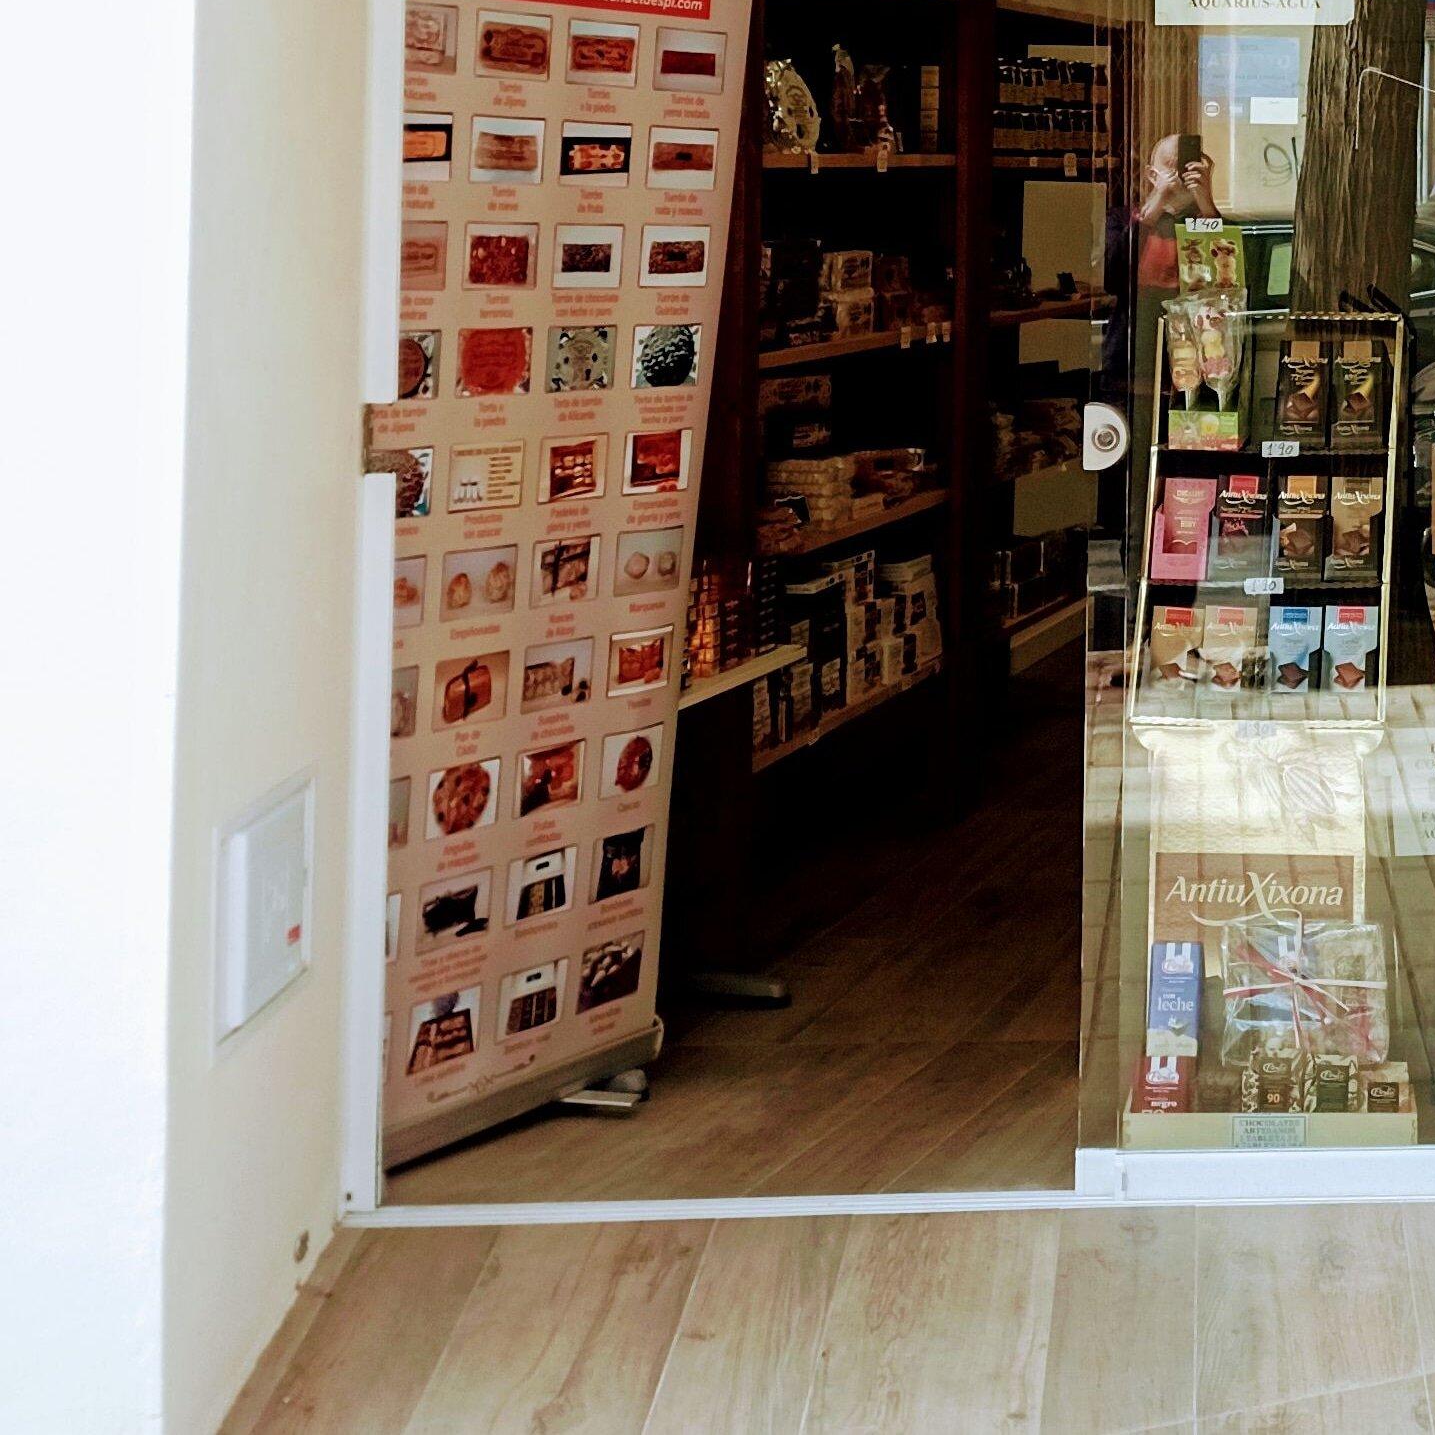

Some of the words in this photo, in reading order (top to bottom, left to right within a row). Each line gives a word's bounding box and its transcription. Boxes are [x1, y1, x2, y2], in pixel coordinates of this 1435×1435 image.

[1165, 871, 1343, 917] AntiuXixona
[1157, 996, 1195, 1012] leche
[1266, 1092, 1281, 1104] 90
